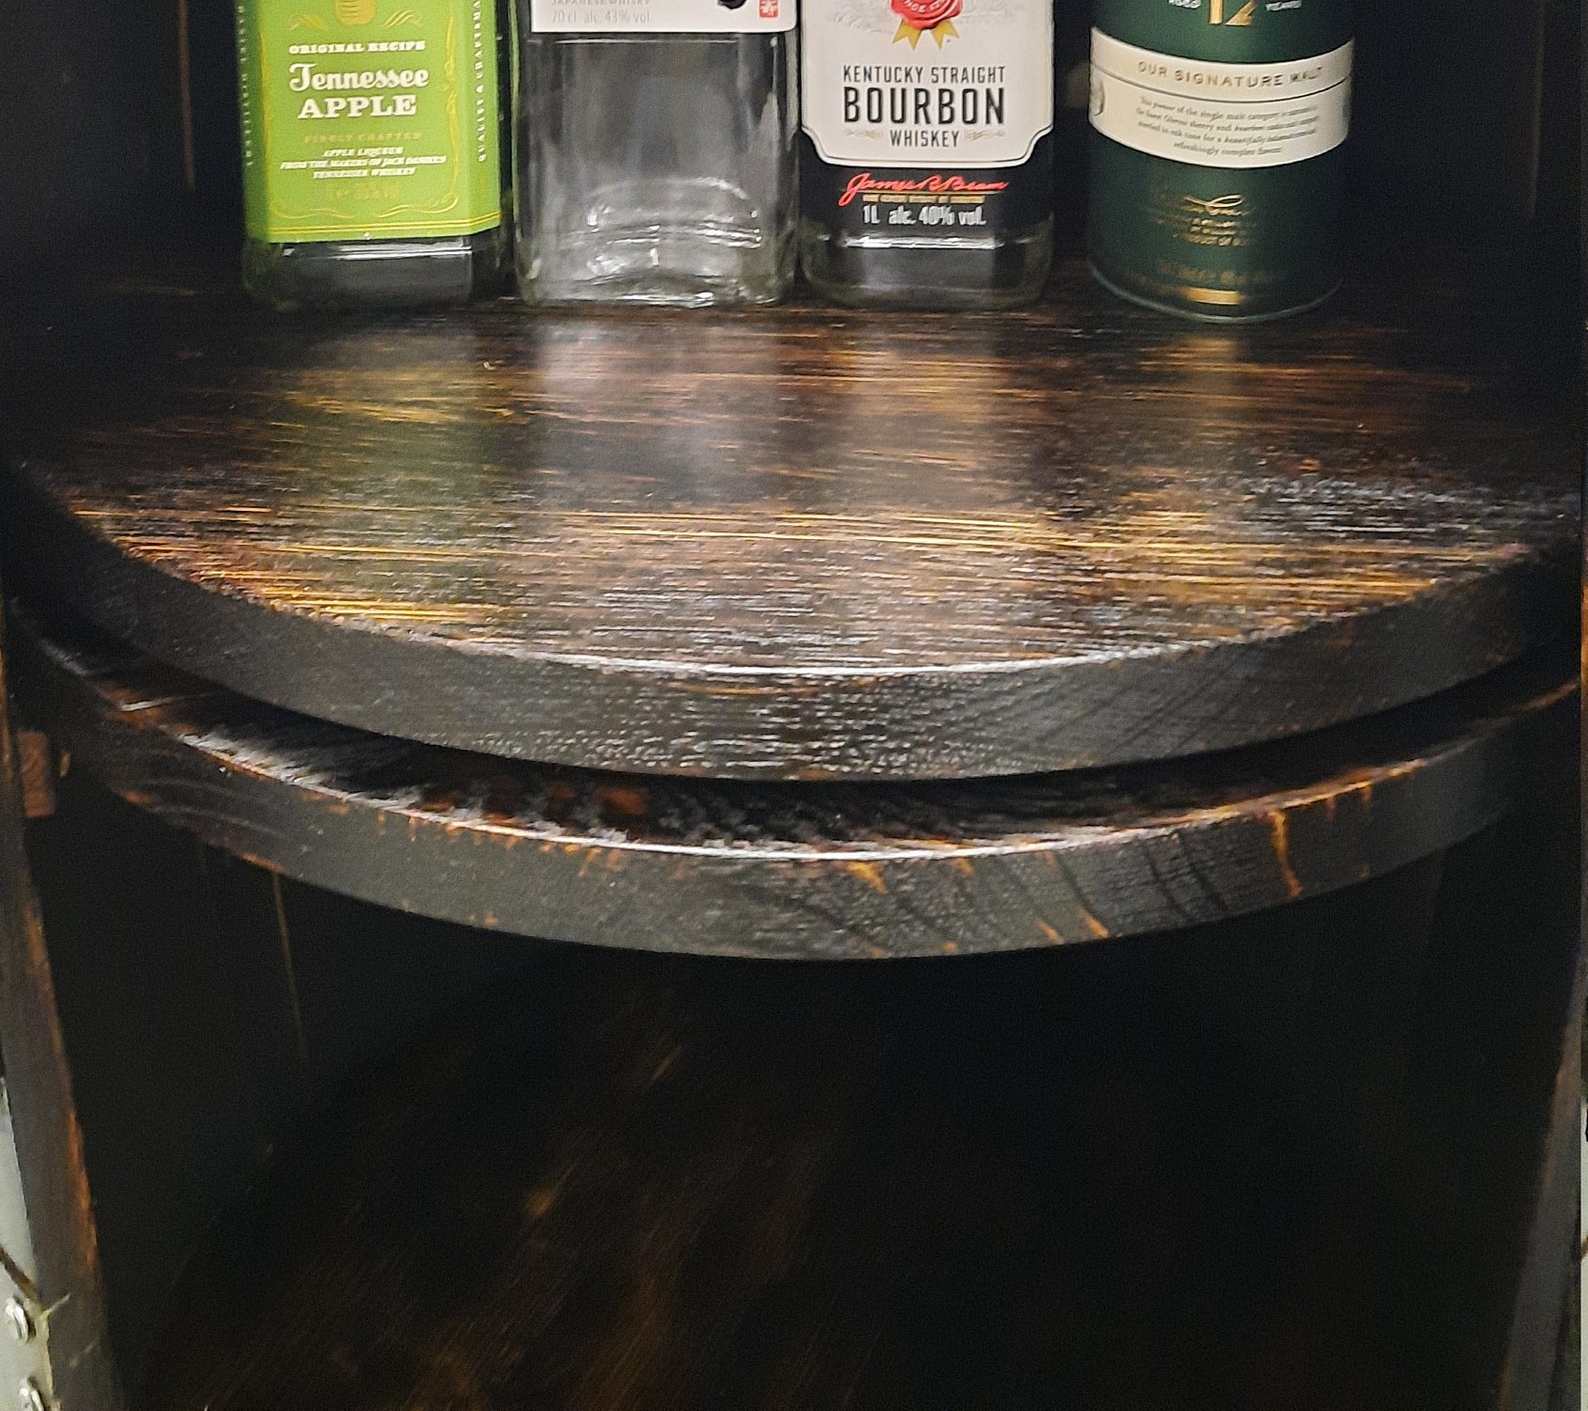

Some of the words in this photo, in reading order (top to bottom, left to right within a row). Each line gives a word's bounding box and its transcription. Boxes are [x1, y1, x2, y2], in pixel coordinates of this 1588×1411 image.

[288, 42, 365, 54] ORIGINAL
[368, 40, 426, 52] RECIPE
[289, 63, 429, 92] Tennessee
[843, 64, 924, 83] KENTUCKY
[931, 66, 1006, 84] STRAIGHT
[1138, 60, 1168, 78] OUR
[1174, 68, 1284, 88] SIGNATURE
[297, 94, 417, 119] APPLE
[843, 86, 1005, 125] BOURBON
[889, 129, 960, 148] WHISKEY
[863, 205, 881, 224] 1L
[919, 205, 955, 226] 40%
[958, 206, 987, 226] vol.
